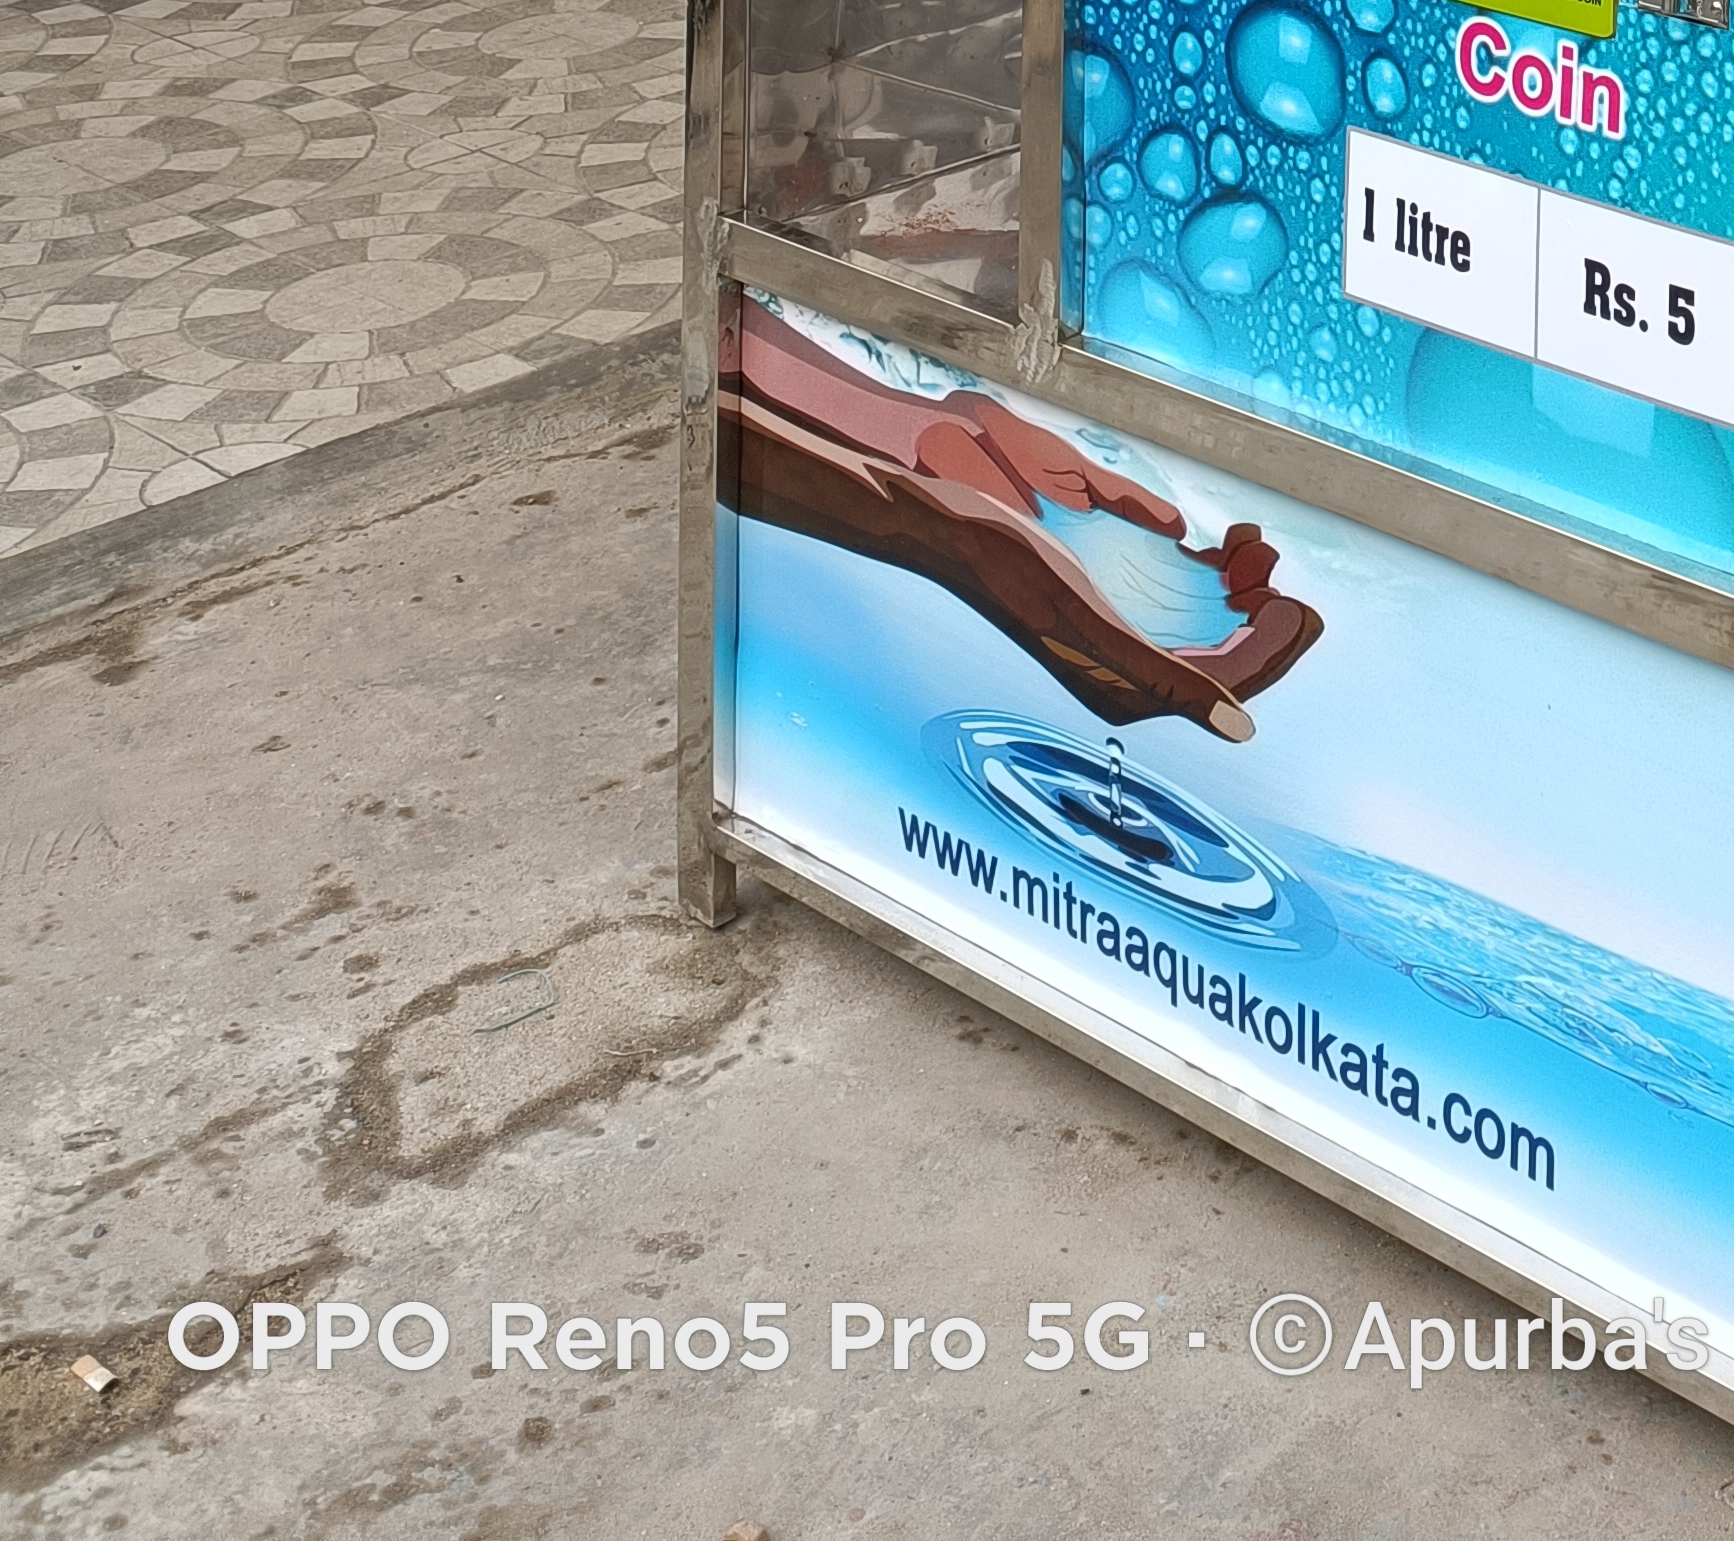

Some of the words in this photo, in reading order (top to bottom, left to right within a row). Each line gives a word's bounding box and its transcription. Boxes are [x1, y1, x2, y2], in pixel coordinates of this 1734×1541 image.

[1458, 21, 1623, 136] Coin
[1394, 197, 1472, 274] litre
[1583, 257, 1648, 336] Rs.
[1668, 286, 1696, 347] 5
[897, 806, 1557, 1192] www.mitraaquakolkata.com
